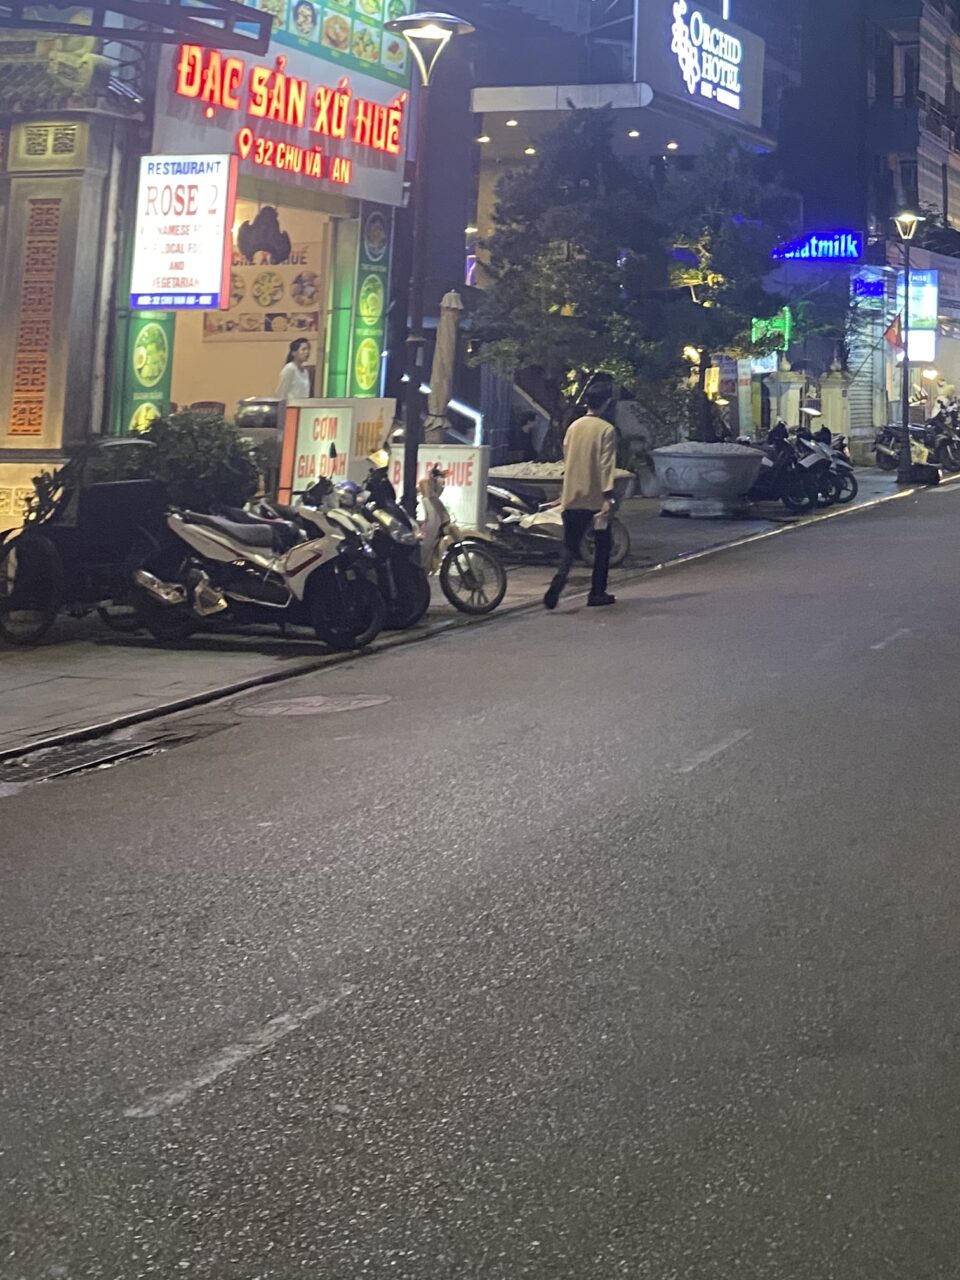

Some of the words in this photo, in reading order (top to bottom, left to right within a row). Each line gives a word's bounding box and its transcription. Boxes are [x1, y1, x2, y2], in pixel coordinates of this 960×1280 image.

[690, 11, 742, 65] ORCHID
[702, 51, 741, 93] HOTEL
[248, 55, 308, 128] SẢN
[309, 76, 352, 140] XỨ
[353, 92, 409, 155] HUẾ
[147, 161, 222, 176] RESTAURANT
[255, 138, 273, 166] 32
[275, 142, 302, 173] CHU
[332, 157, 351, 184] AN
[145, 183, 199, 216] ROSE
[207, 184, 219, 215] 2
[312, 416, 338, 441] CƠM
[297, 455, 316, 479] GIA
